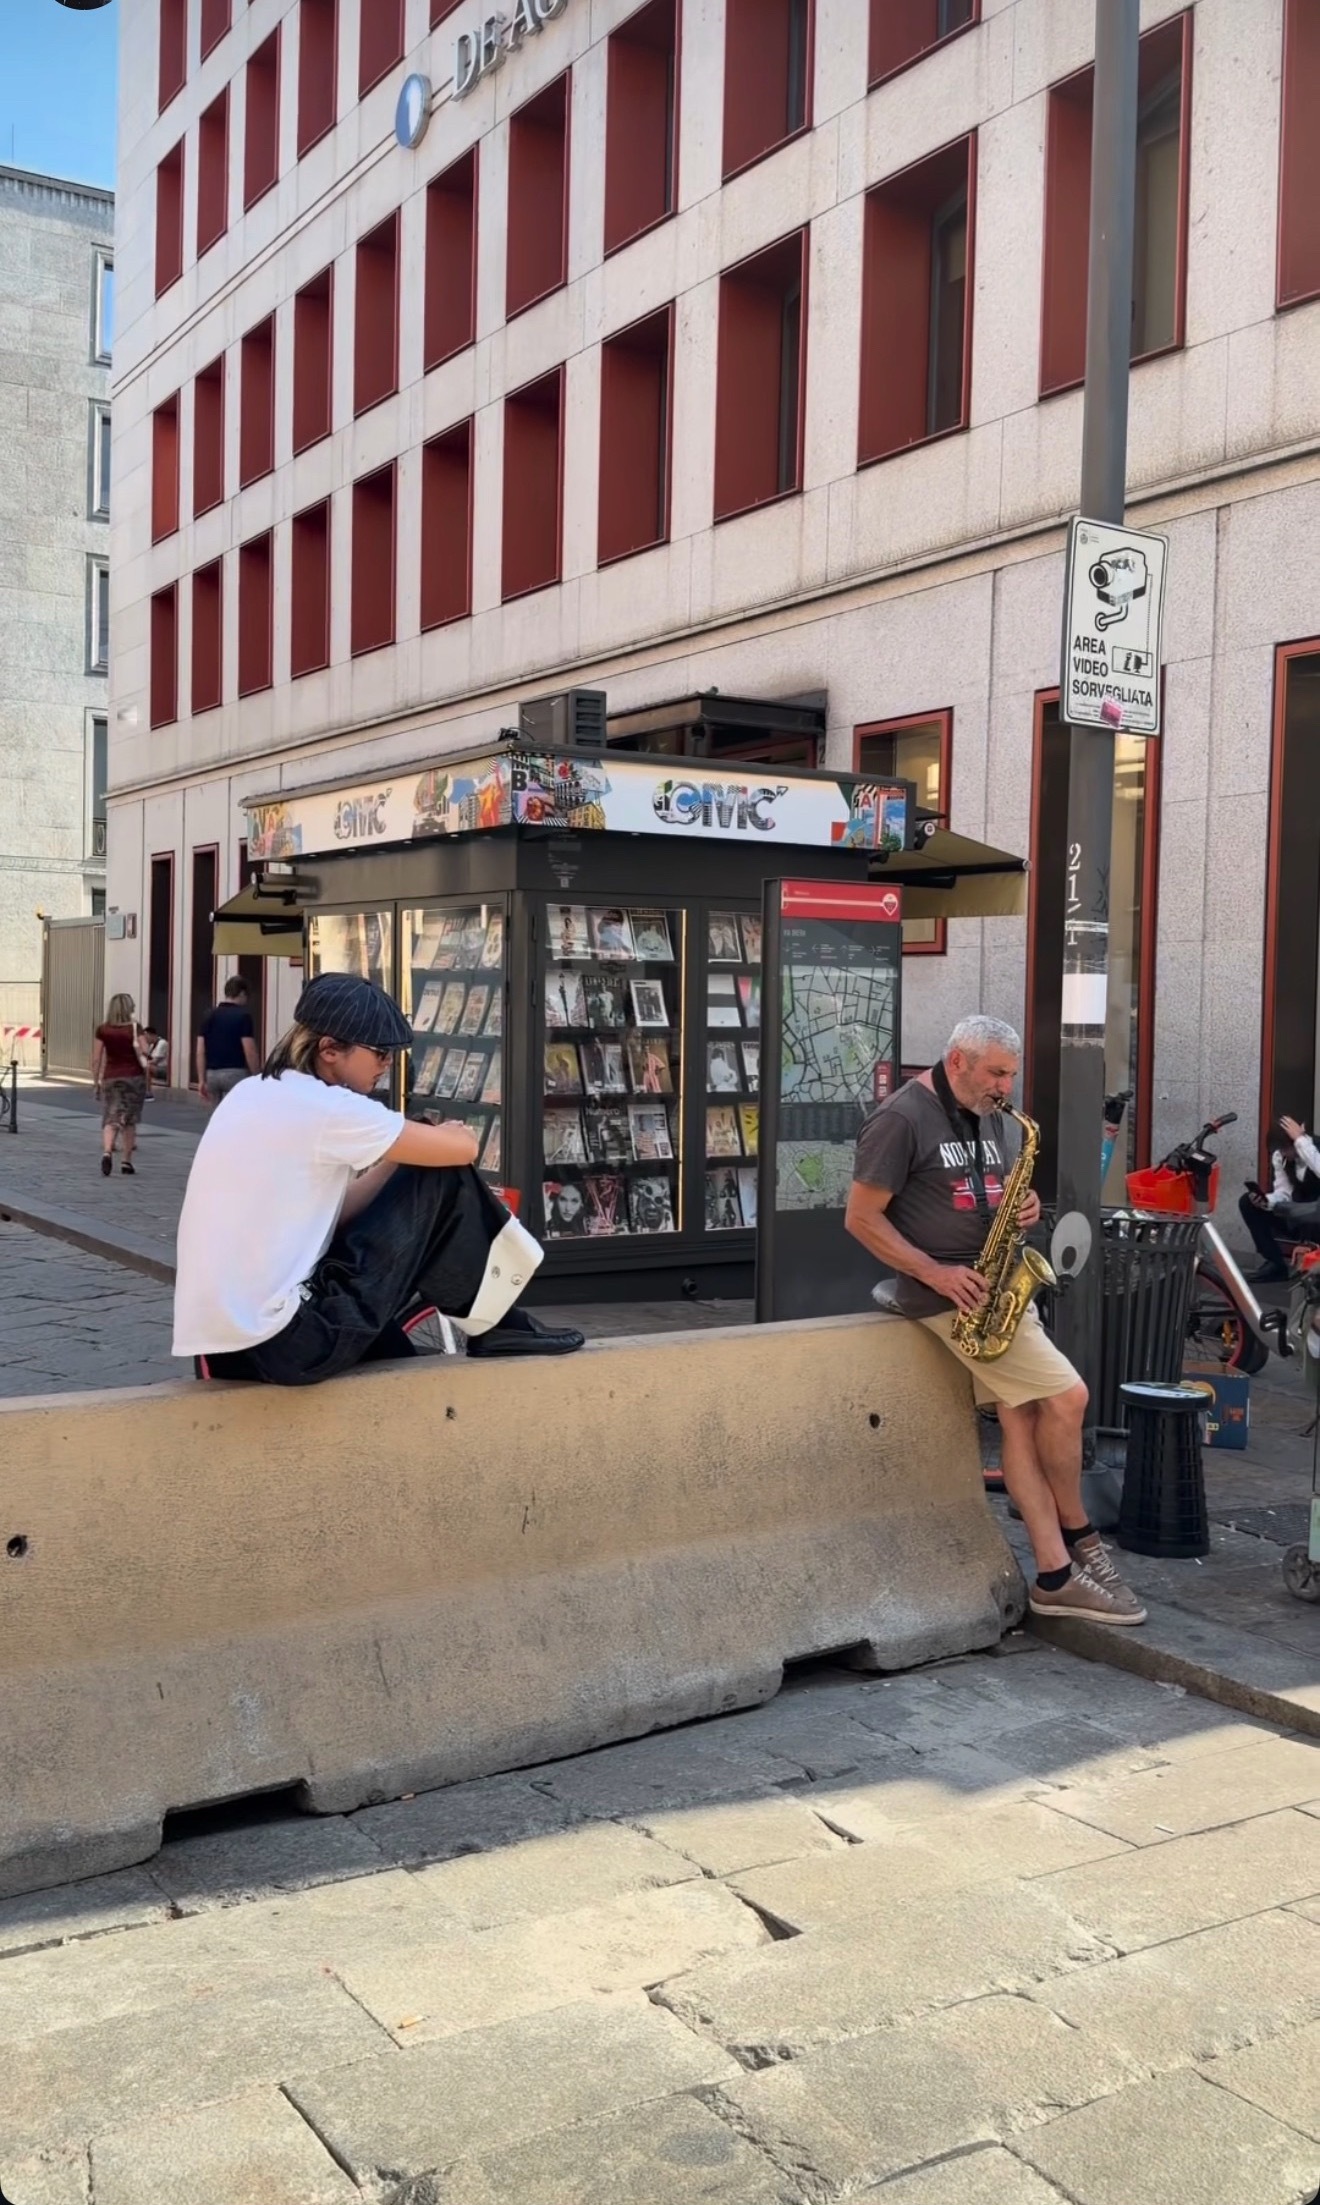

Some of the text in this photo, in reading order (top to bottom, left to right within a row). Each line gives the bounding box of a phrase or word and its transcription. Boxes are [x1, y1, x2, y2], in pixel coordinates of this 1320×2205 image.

[450, 0, 567, 102] DE A
[1073, 635, 1106, 655] AREA
[1073, 656, 1109, 677] VIDEO
[1072, 679, 1154, 707] SORVEGLIATA
